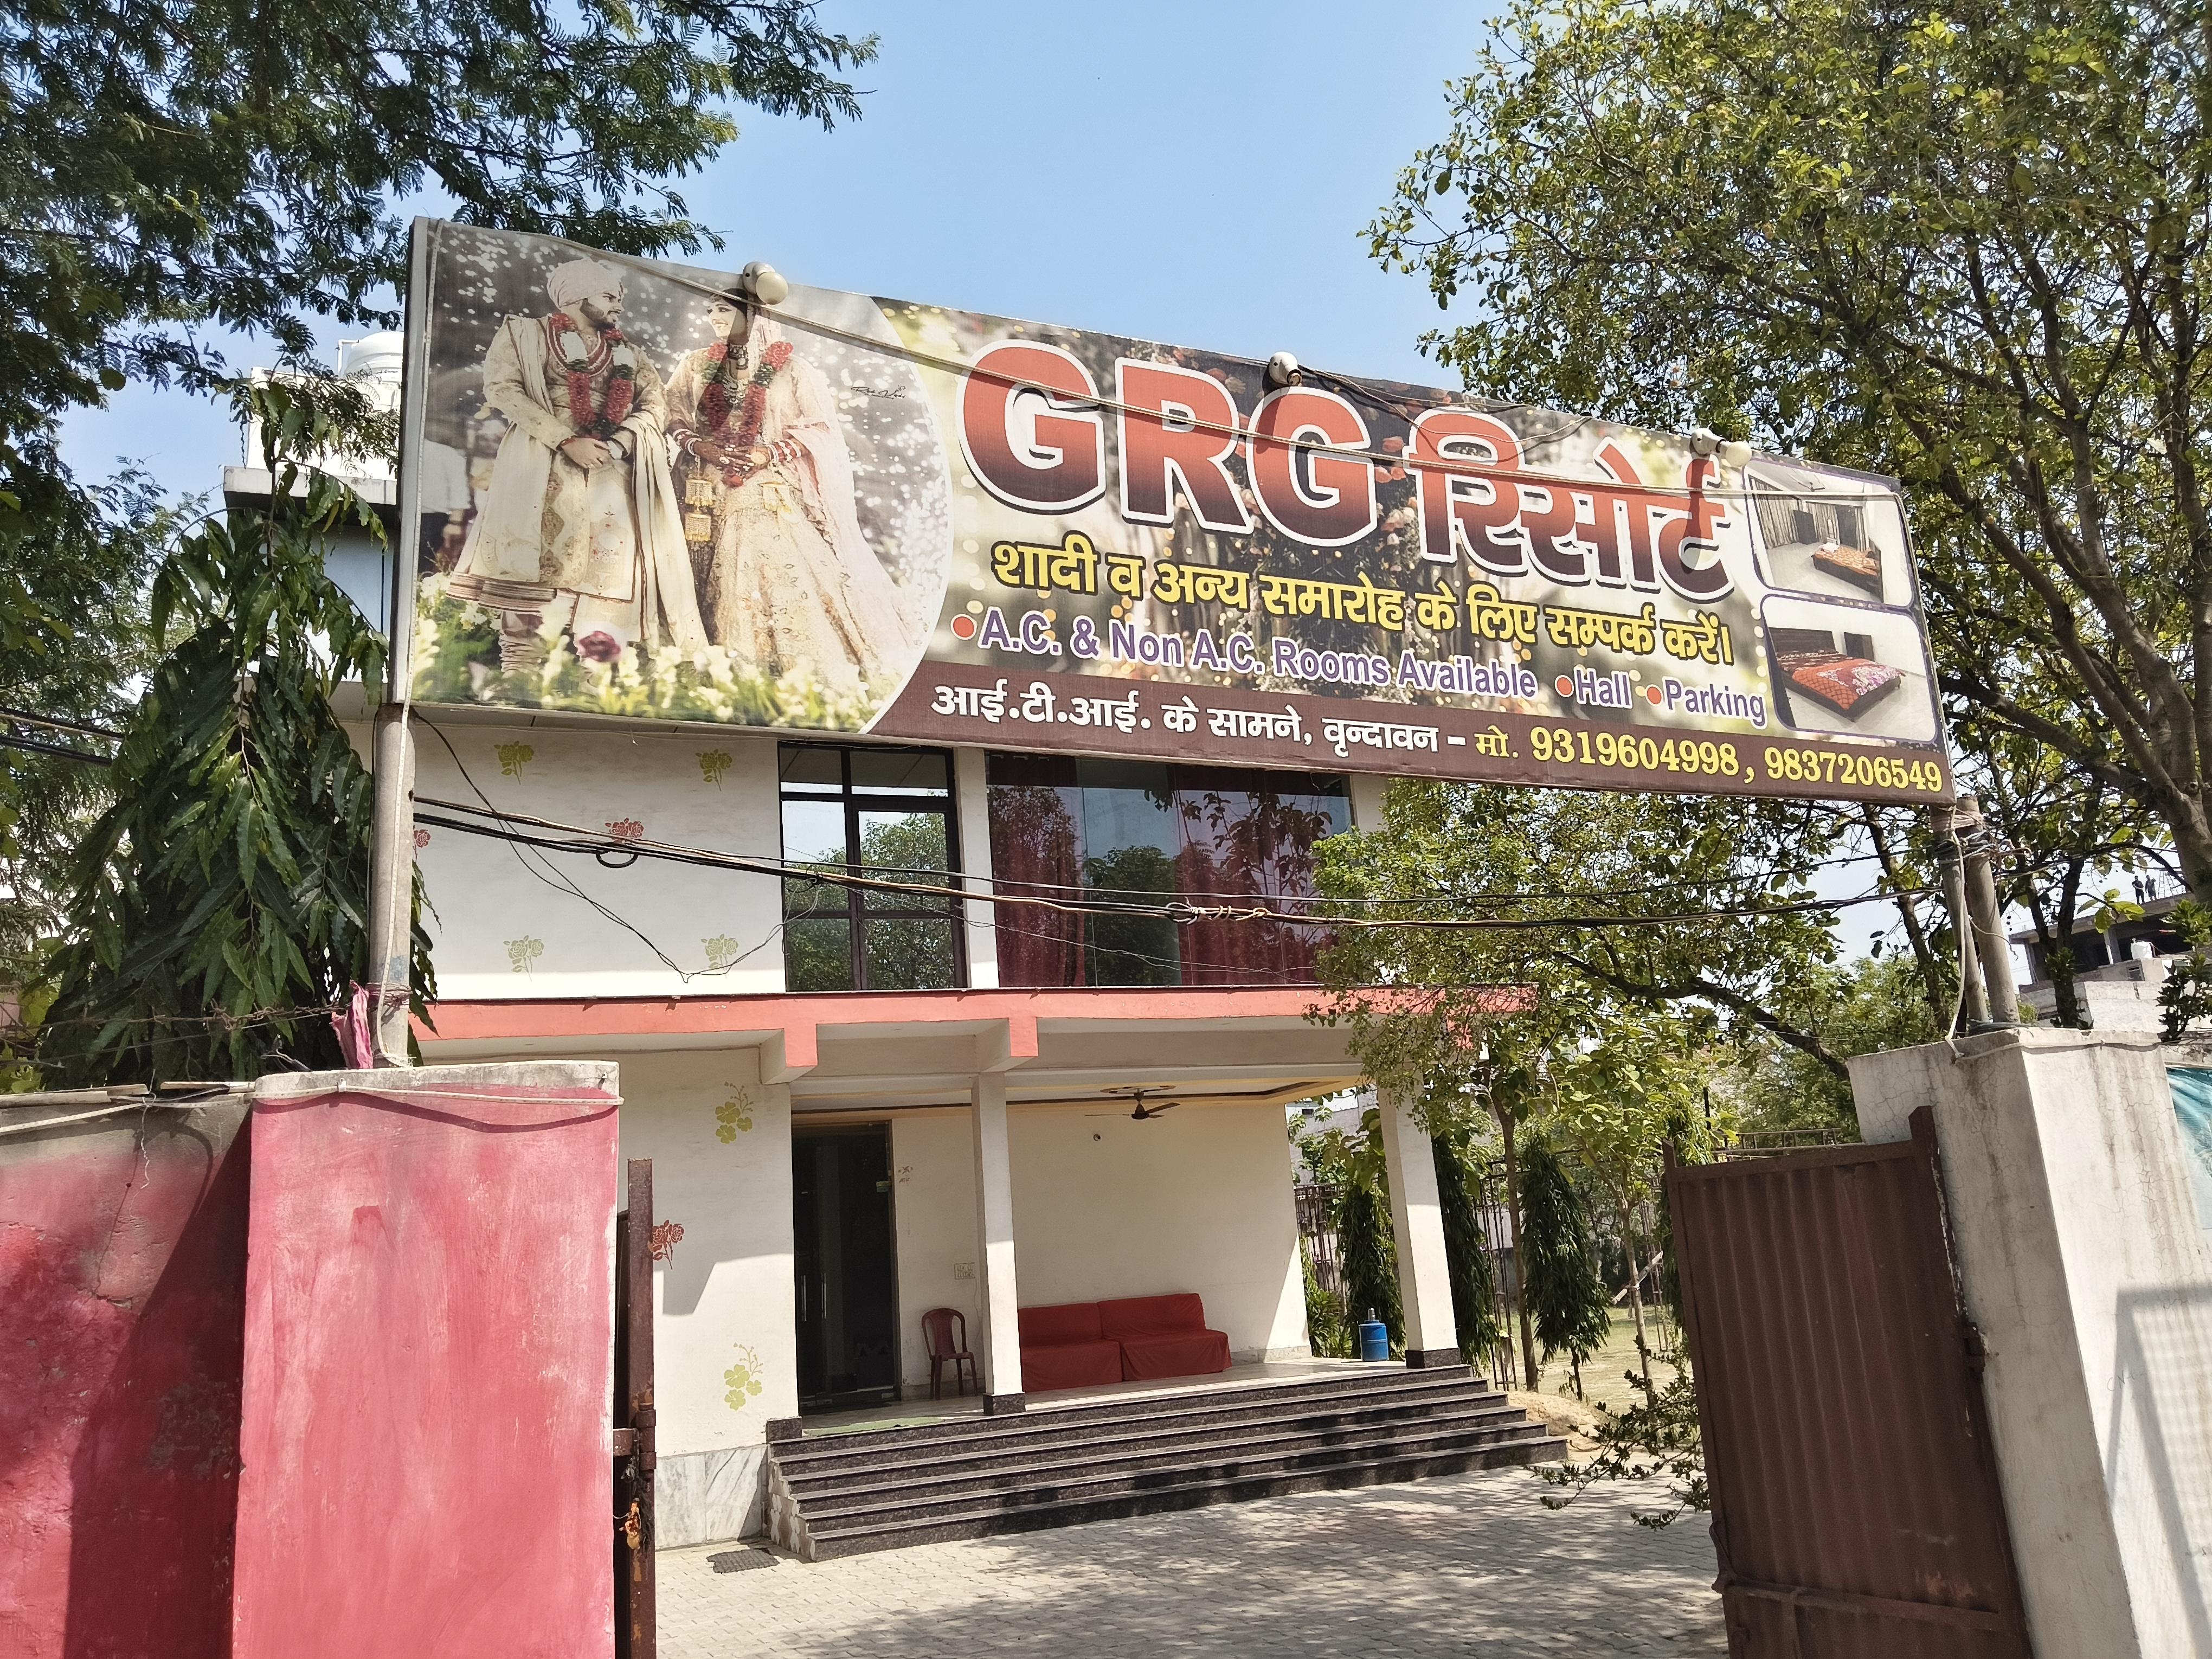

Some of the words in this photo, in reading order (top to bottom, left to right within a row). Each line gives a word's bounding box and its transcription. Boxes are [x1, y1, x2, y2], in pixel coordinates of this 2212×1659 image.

[959, 342, 1376, 544] GRG
[1405, 409, 1734, 597] रिसोर्ट
[994, 534, 1097, 594] शादी
[1109, 557, 1142, 597] व
[1155, 564, 1250, 608] अन्य
[1259, 574, 1406, 631] समारोह
[1414, 583, 1456, 630] के
[1465, 586, 1536, 644] लिए
[1546, 605, 1655, 655] सम्पर्क
[982, 609, 1059, 653] A.C.
[1075, 619, 1099, 657] &
[1112, 623, 1182, 665] Non
[1193, 632, 1263, 672] A.C.
[1275, 641, 1389, 684] Rooms
[1399, 654, 1536, 698] Available
[1577, 670, 1630, 705] Hall
[1666, 683, 1764, 725] Parking
[931, 680, 1152, 734] आई.टी.आई.
[1161, 696, 1199, 732] के
[1206, 705, 1313, 745] सामने,
[1321, 718, 1439, 757] वृन्दावन
[1475, 725, 1519, 758] मो.
[1764, 747, 1943, 792] 9837206549
